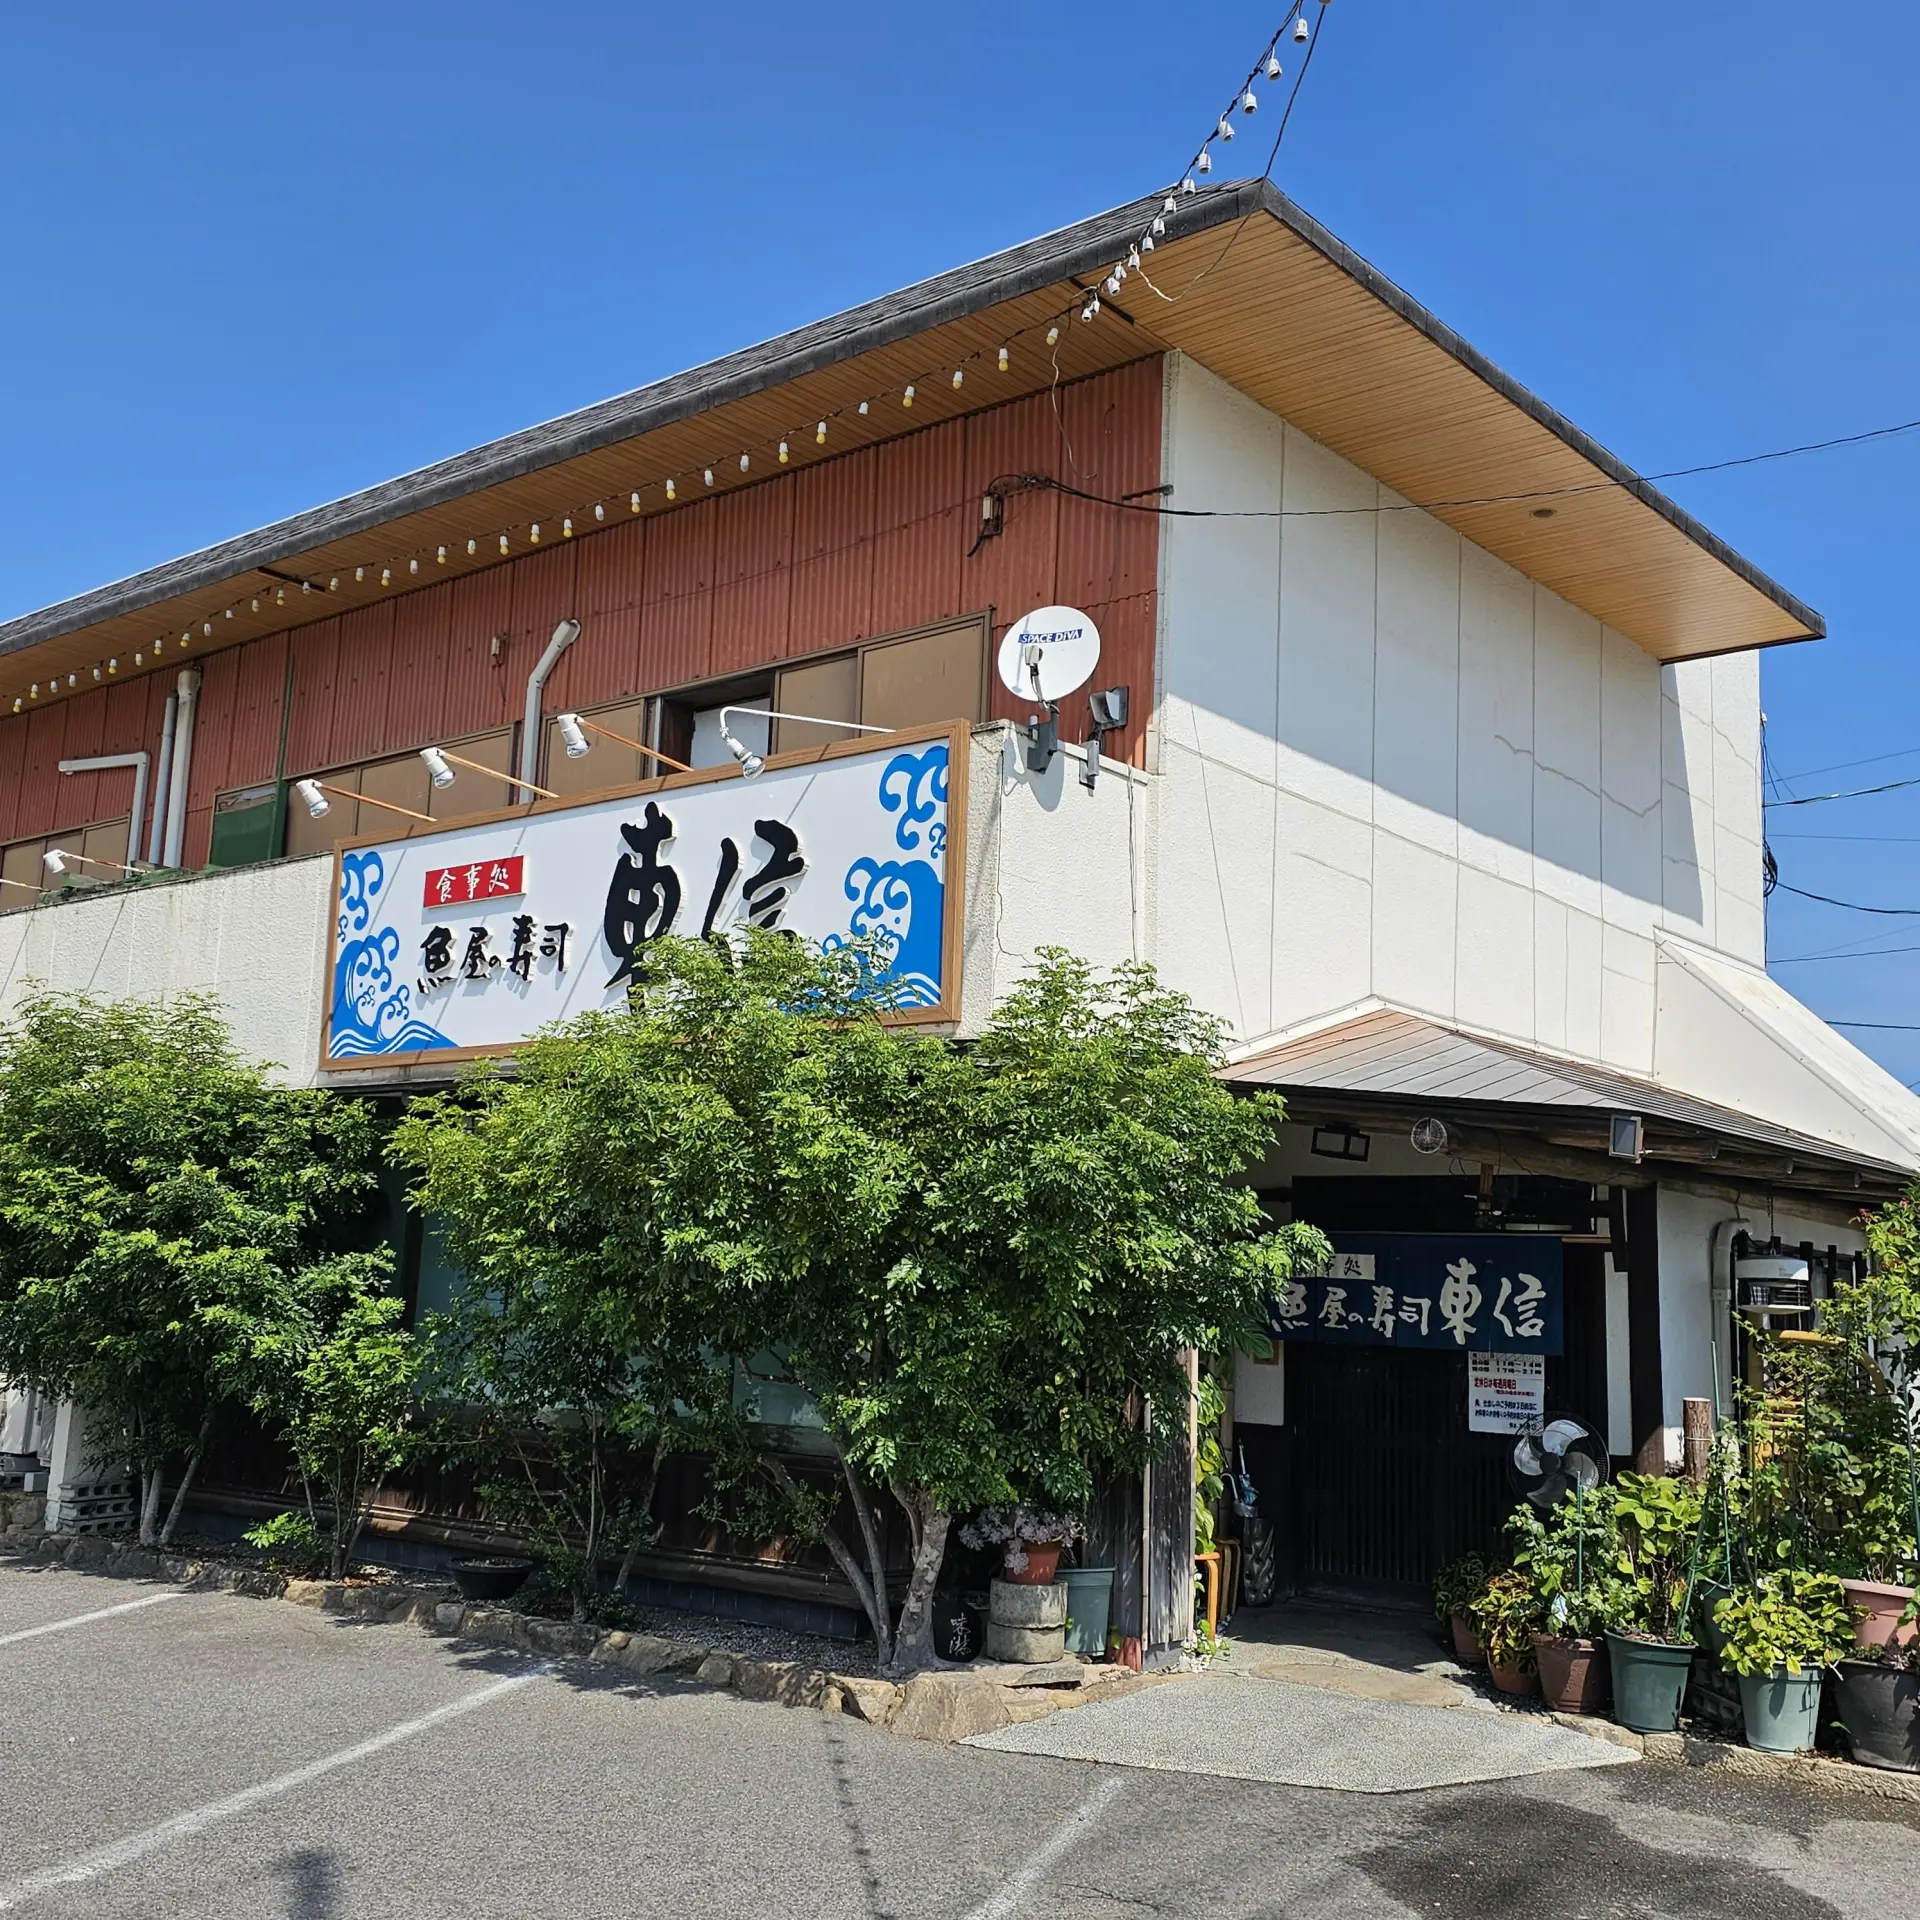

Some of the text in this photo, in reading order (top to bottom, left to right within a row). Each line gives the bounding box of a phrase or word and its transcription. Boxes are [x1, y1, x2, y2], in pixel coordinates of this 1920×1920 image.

[1021, 633, 1053, 643] SPACE
[436, 863, 509, 903] 食事処
[416, 914, 572, 995] 魚屋の寿司
[1439, 1257, 1546, 1345] 東信
